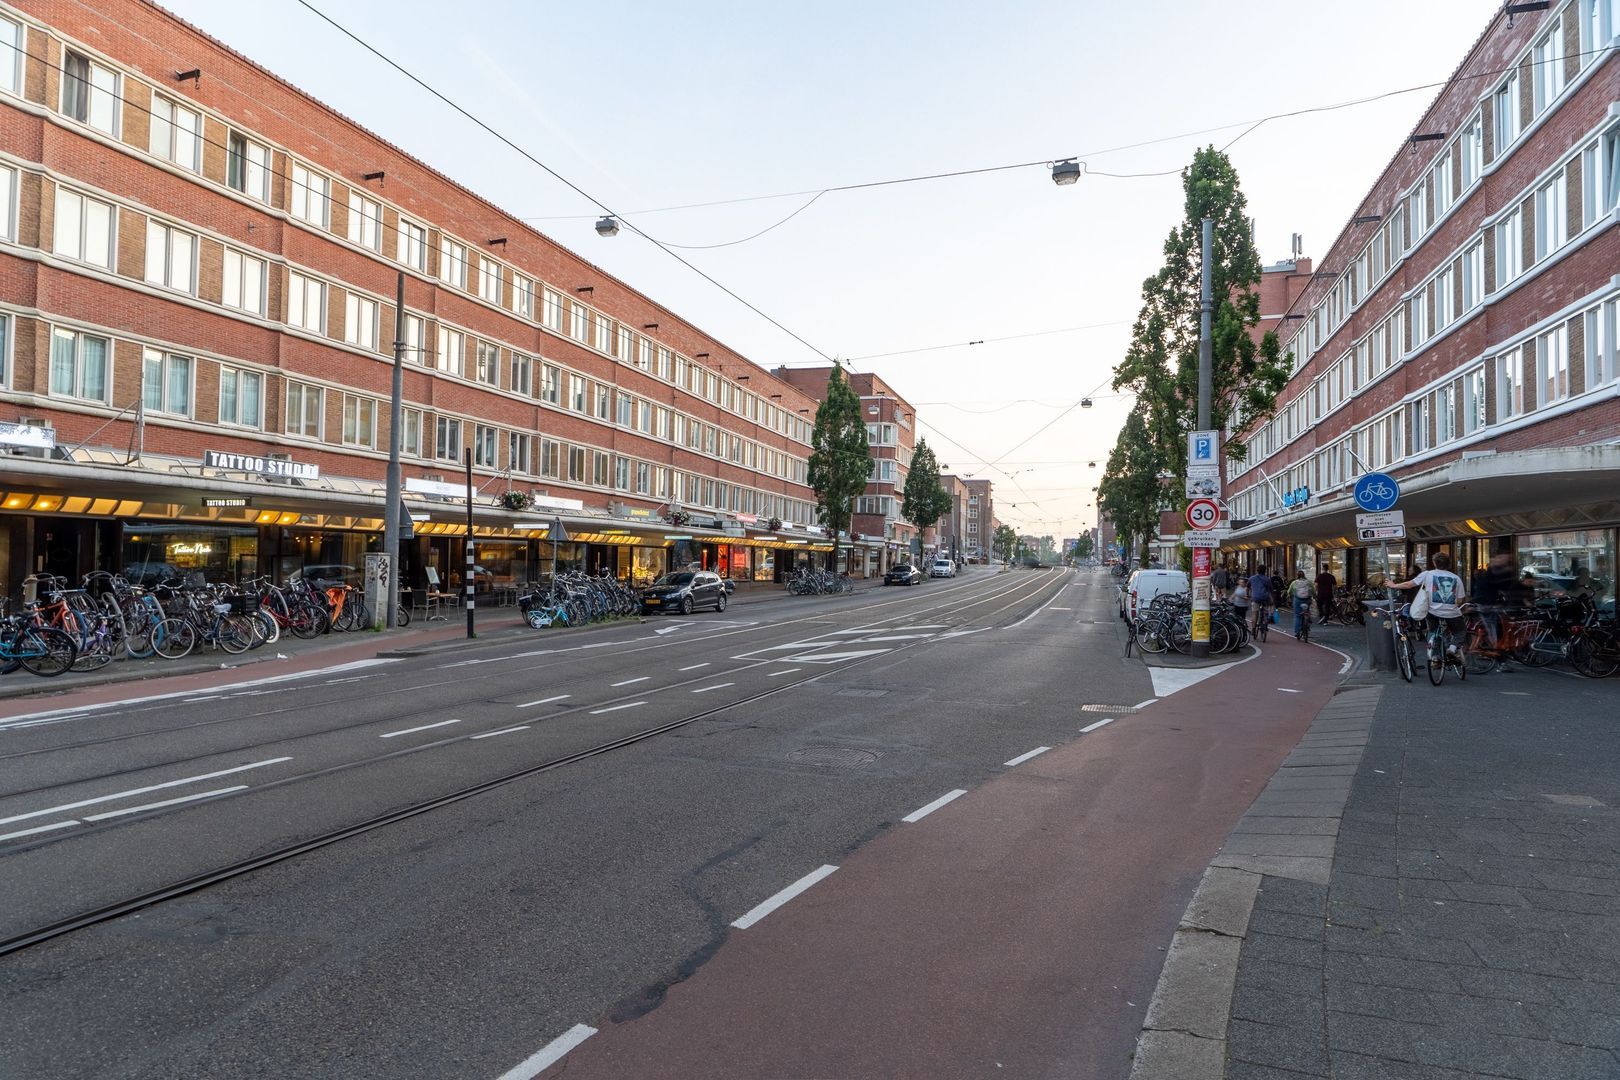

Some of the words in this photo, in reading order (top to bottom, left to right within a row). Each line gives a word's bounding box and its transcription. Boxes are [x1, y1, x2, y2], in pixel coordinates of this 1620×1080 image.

[1198, 440, 1207, 451] P
[210, 452, 263, 472] TATTOO
[1193, 509, 1214, 521] 30
